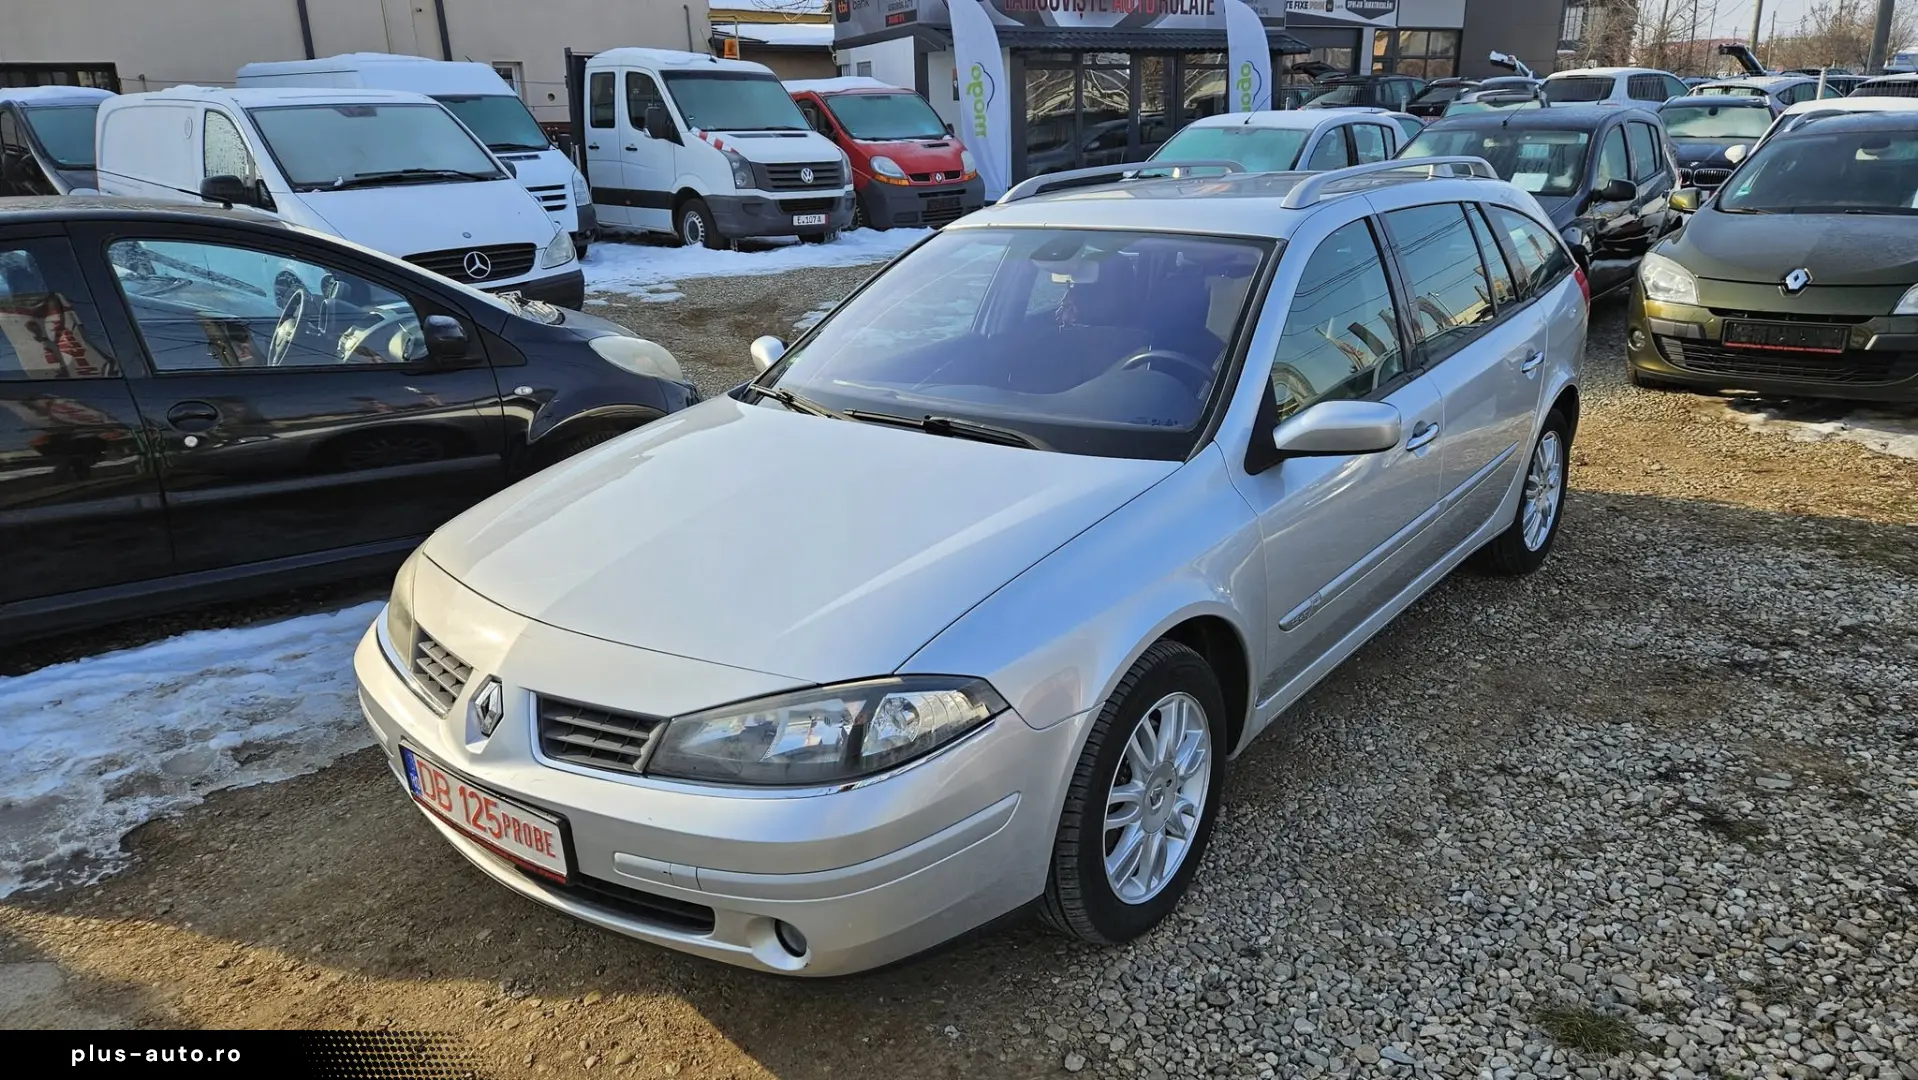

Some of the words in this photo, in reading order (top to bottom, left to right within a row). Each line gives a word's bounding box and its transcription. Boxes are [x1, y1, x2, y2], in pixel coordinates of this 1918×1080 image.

[416, 760, 453, 812] DB
[458, 785, 503, 840] 125
[501, 812, 556, 858] PROBE
